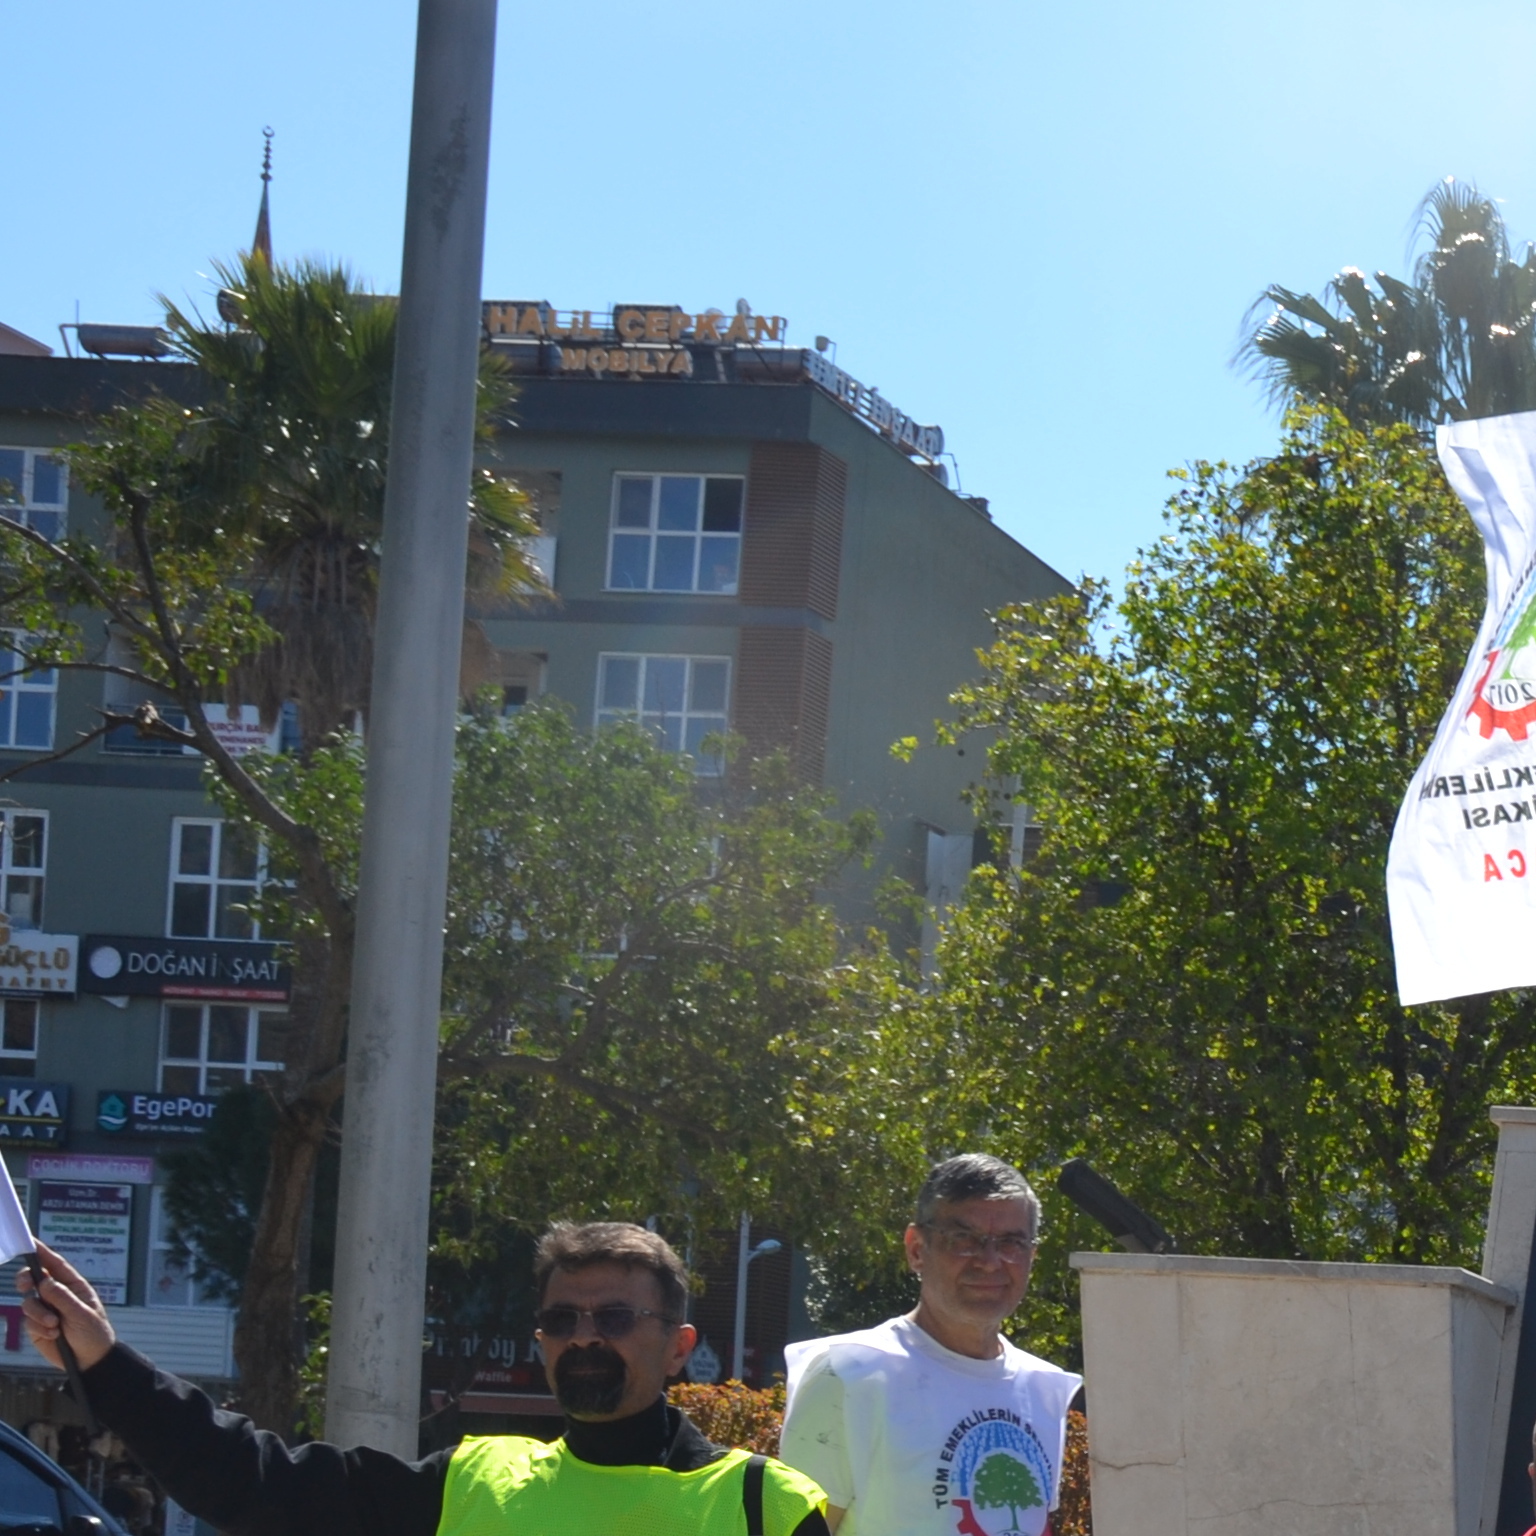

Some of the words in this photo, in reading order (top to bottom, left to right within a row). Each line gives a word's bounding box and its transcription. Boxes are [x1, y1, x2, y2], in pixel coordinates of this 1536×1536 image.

[618, 310, 780, 342] ÇEPKAN
[128, 949, 204, 976] DOĞAN
[134, 1096, 218, 1119] EgePor
